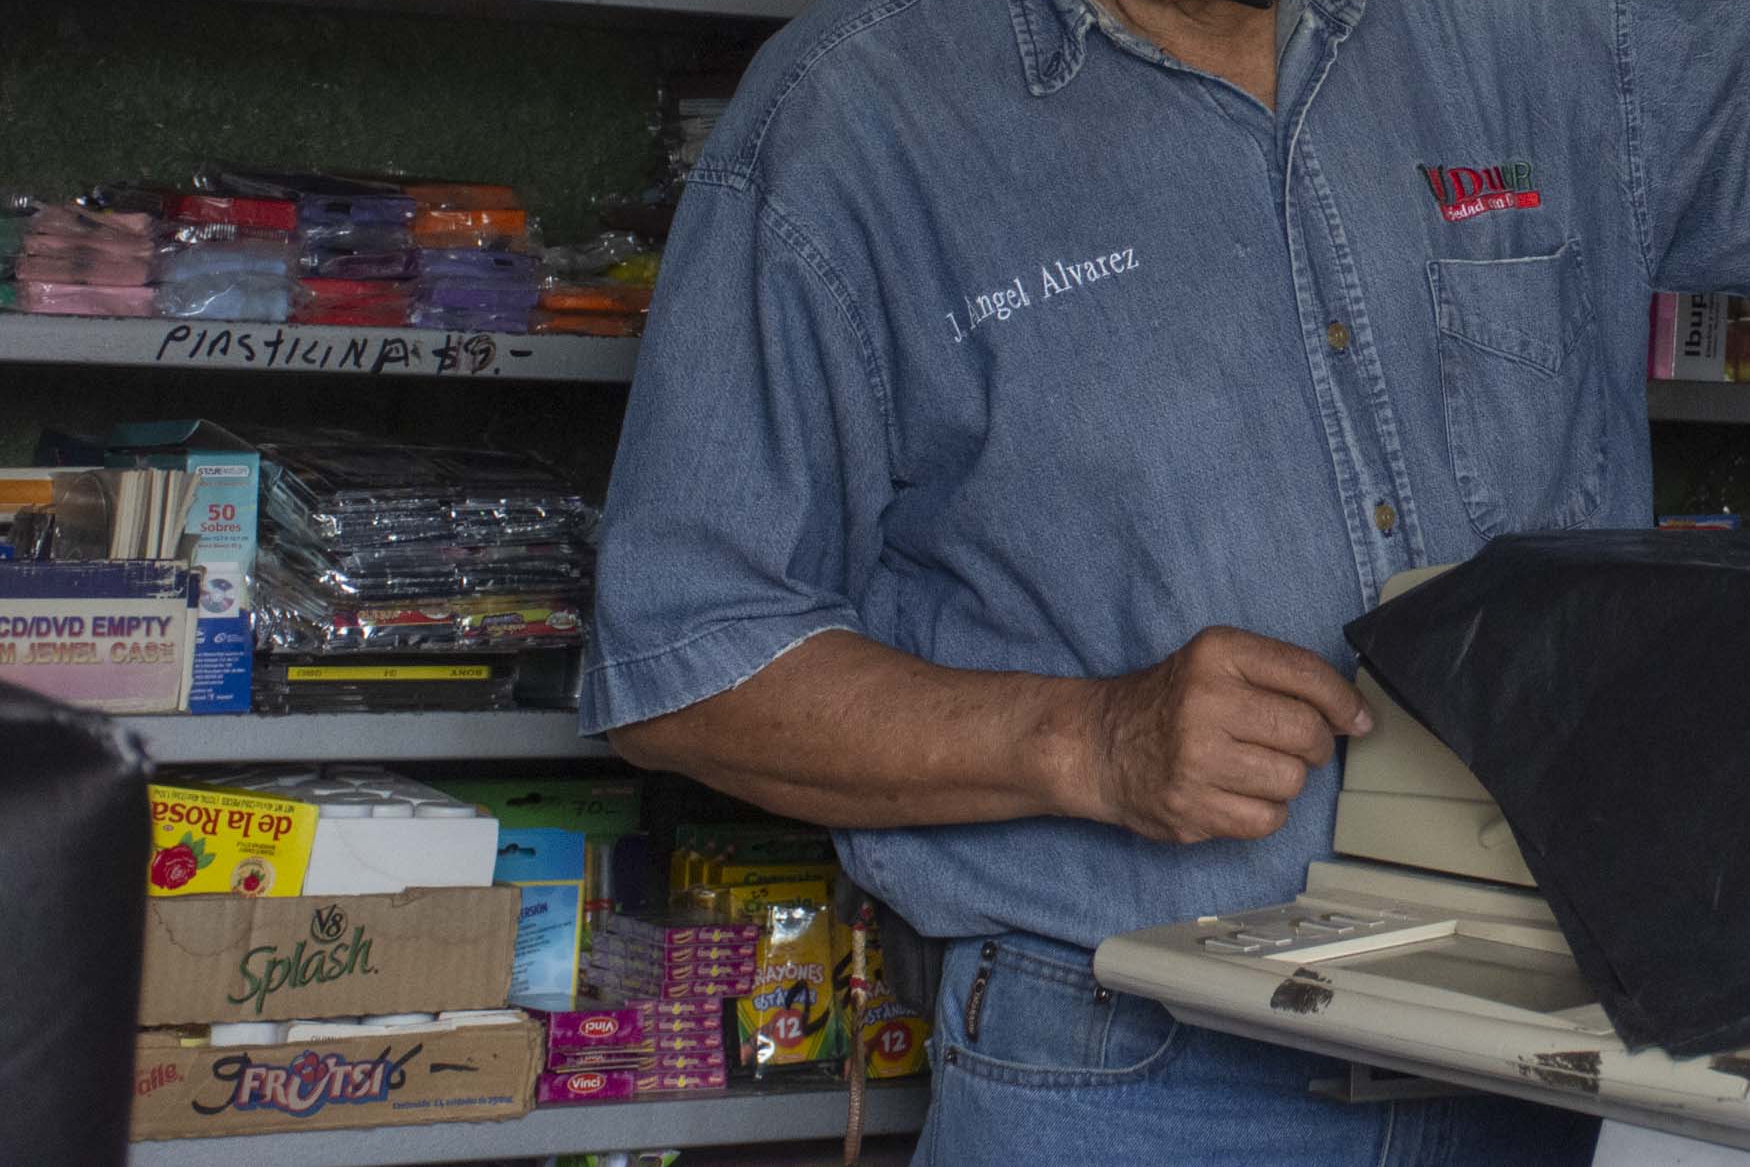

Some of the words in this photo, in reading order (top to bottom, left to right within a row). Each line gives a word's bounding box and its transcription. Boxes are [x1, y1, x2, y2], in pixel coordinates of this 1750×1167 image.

[964, 277, 1031, 331] Angel
[1041, 247, 1140, 300] Alvarez
[207, 504, 236, 521] 50
[199, 522, 242, 533] Sobres
[91, 615, 173, 638] EMPTY
[21, 641, 99, 664] JEWEL
[110, 641, 176, 664] CASE
[151, 800, 223, 837] Rosa
[227, 809, 256, 838] la
[258, 814, 293, 842] de
[312, 904, 345, 938] V8
[584, 1021, 615, 1035] Vinci
[775, 1017, 803, 1040] 12
[881, 1030, 907, 1054] 12
[237, 1048, 388, 1118] FRUTSI
[571, 1075, 603, 1090] Vinci
